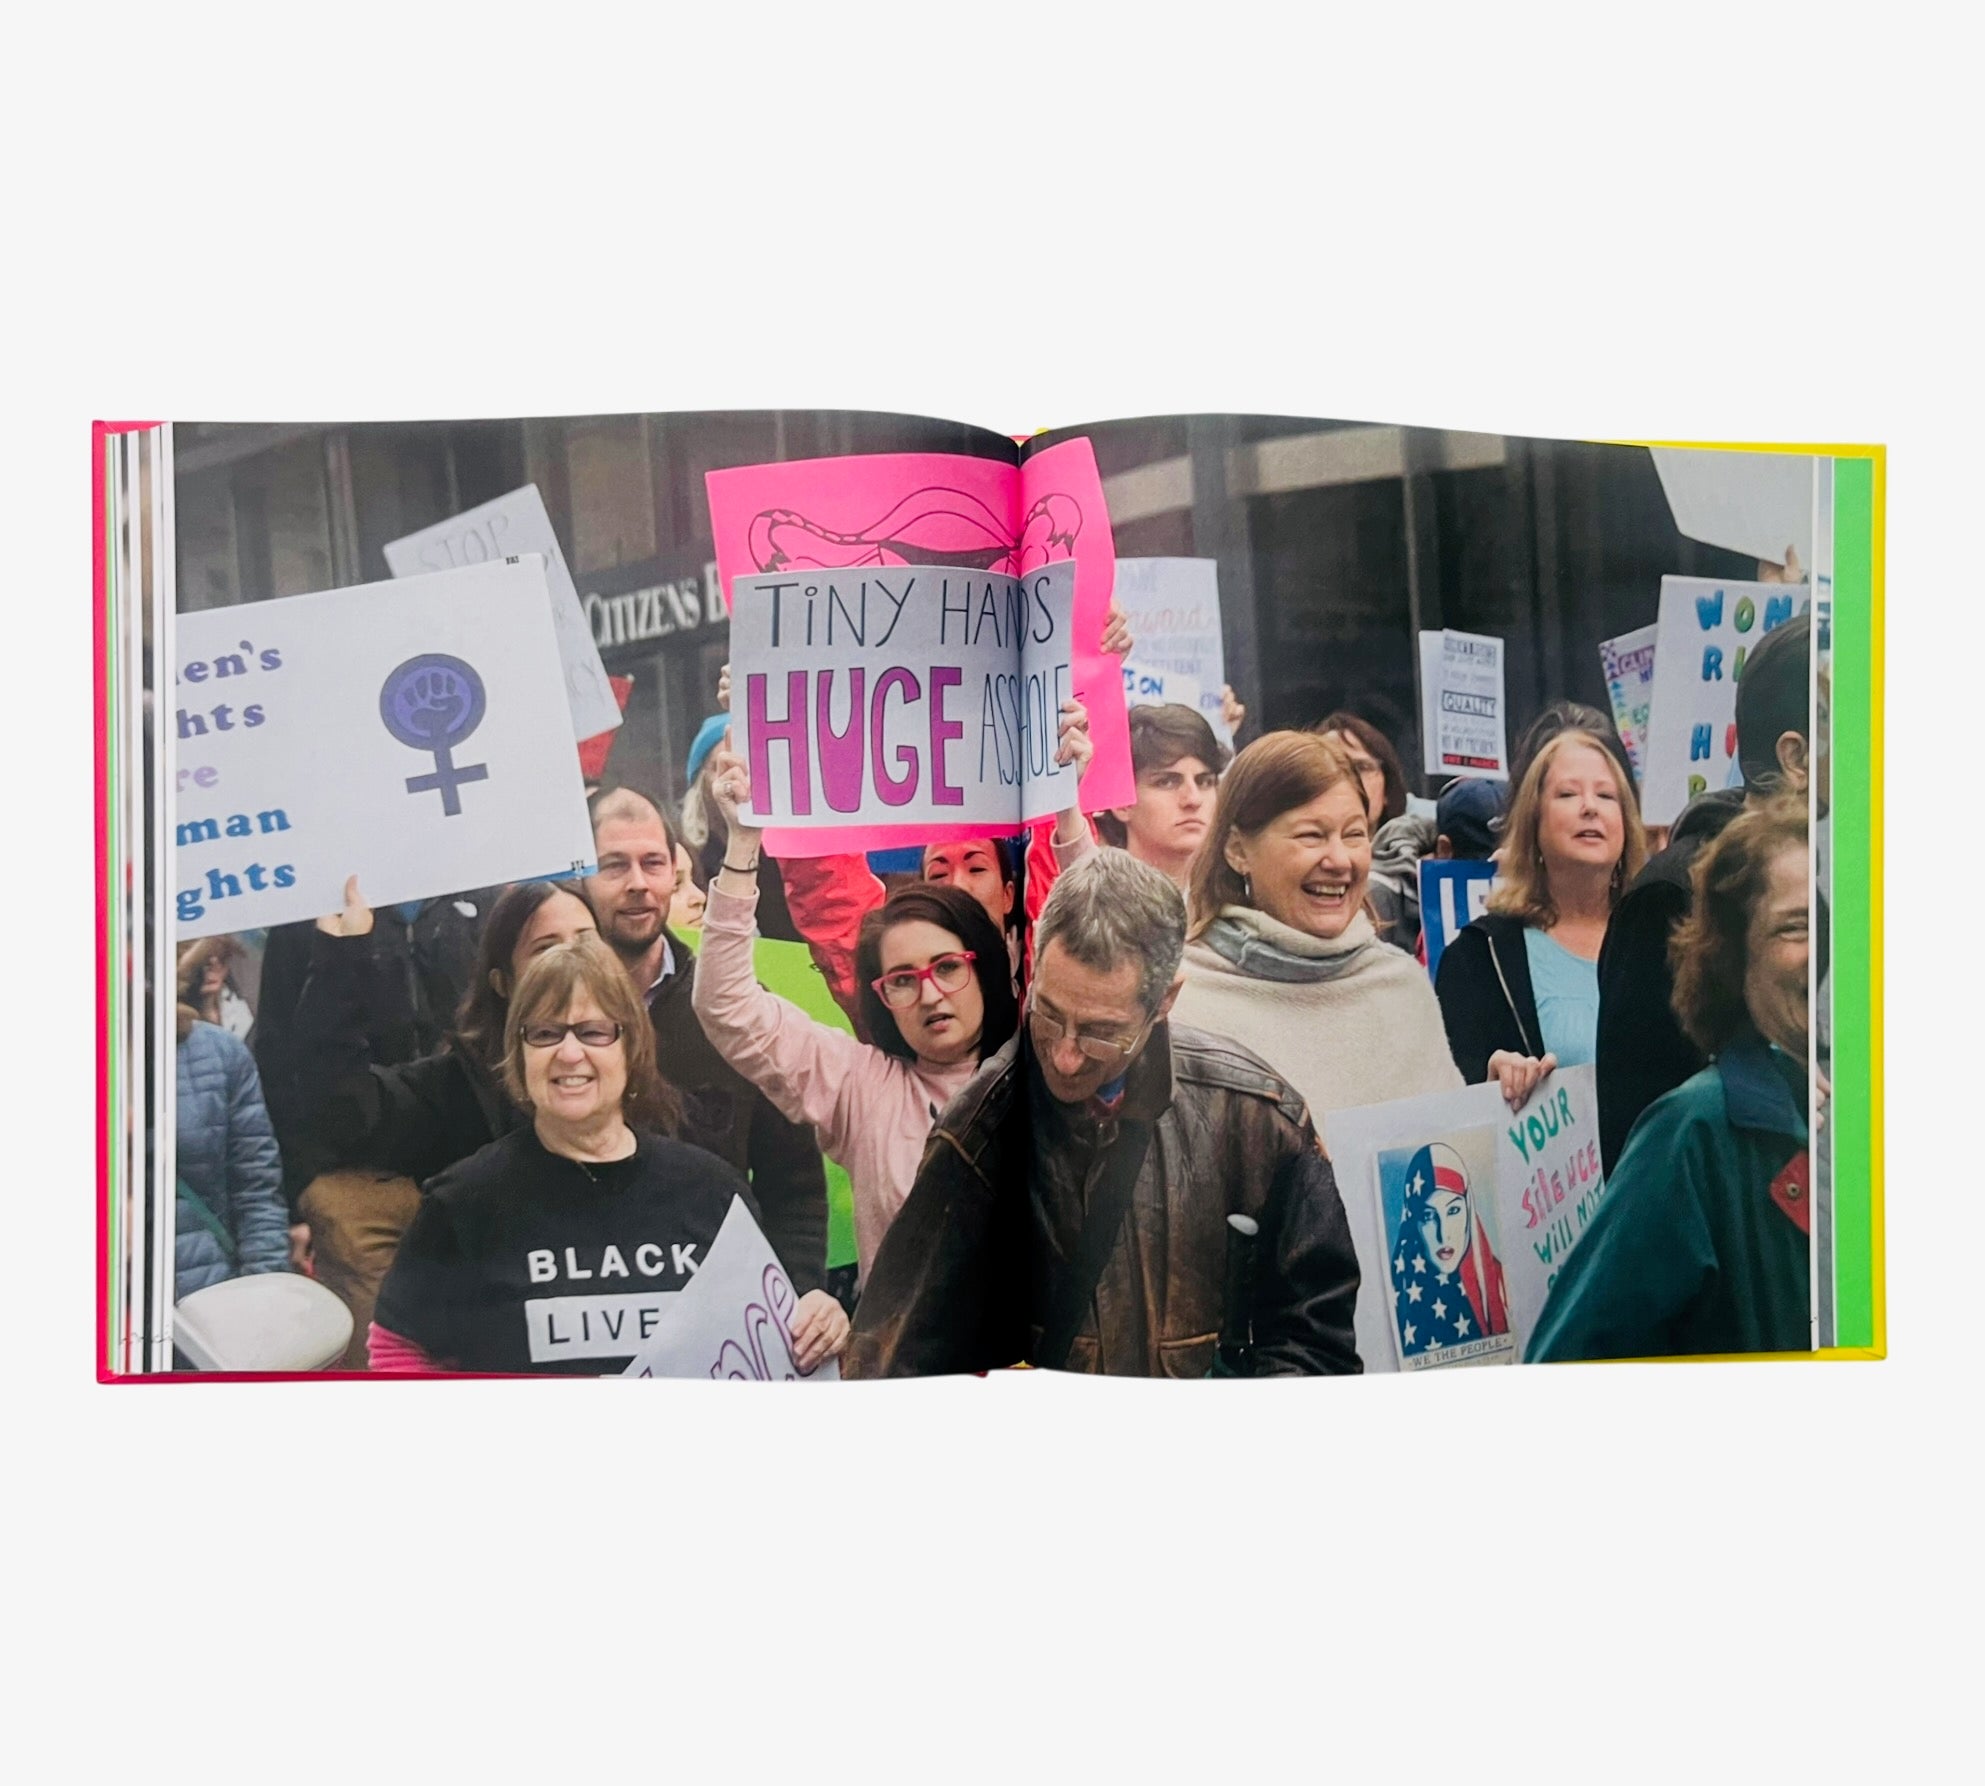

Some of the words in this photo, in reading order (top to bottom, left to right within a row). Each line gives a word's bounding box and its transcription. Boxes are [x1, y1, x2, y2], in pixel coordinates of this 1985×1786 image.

[940, 575, 1054, 653] HANDS
[175, 639, 283, 686] en's
[1139, 675, 1164, 696] ON
[747, 666, 964, 816] HUGE
[979, 663, 1074, 787] ASSHOLE
[1507, 1086, 1576, 1166] YOUR
[527, 1243, 699, 1284] BLACK
[1413, 1356, 1431, 1367] WE
[1434, 1348, 1458, 1362] THE
[1461, 1337, 1502, 1356] PEOPLE
